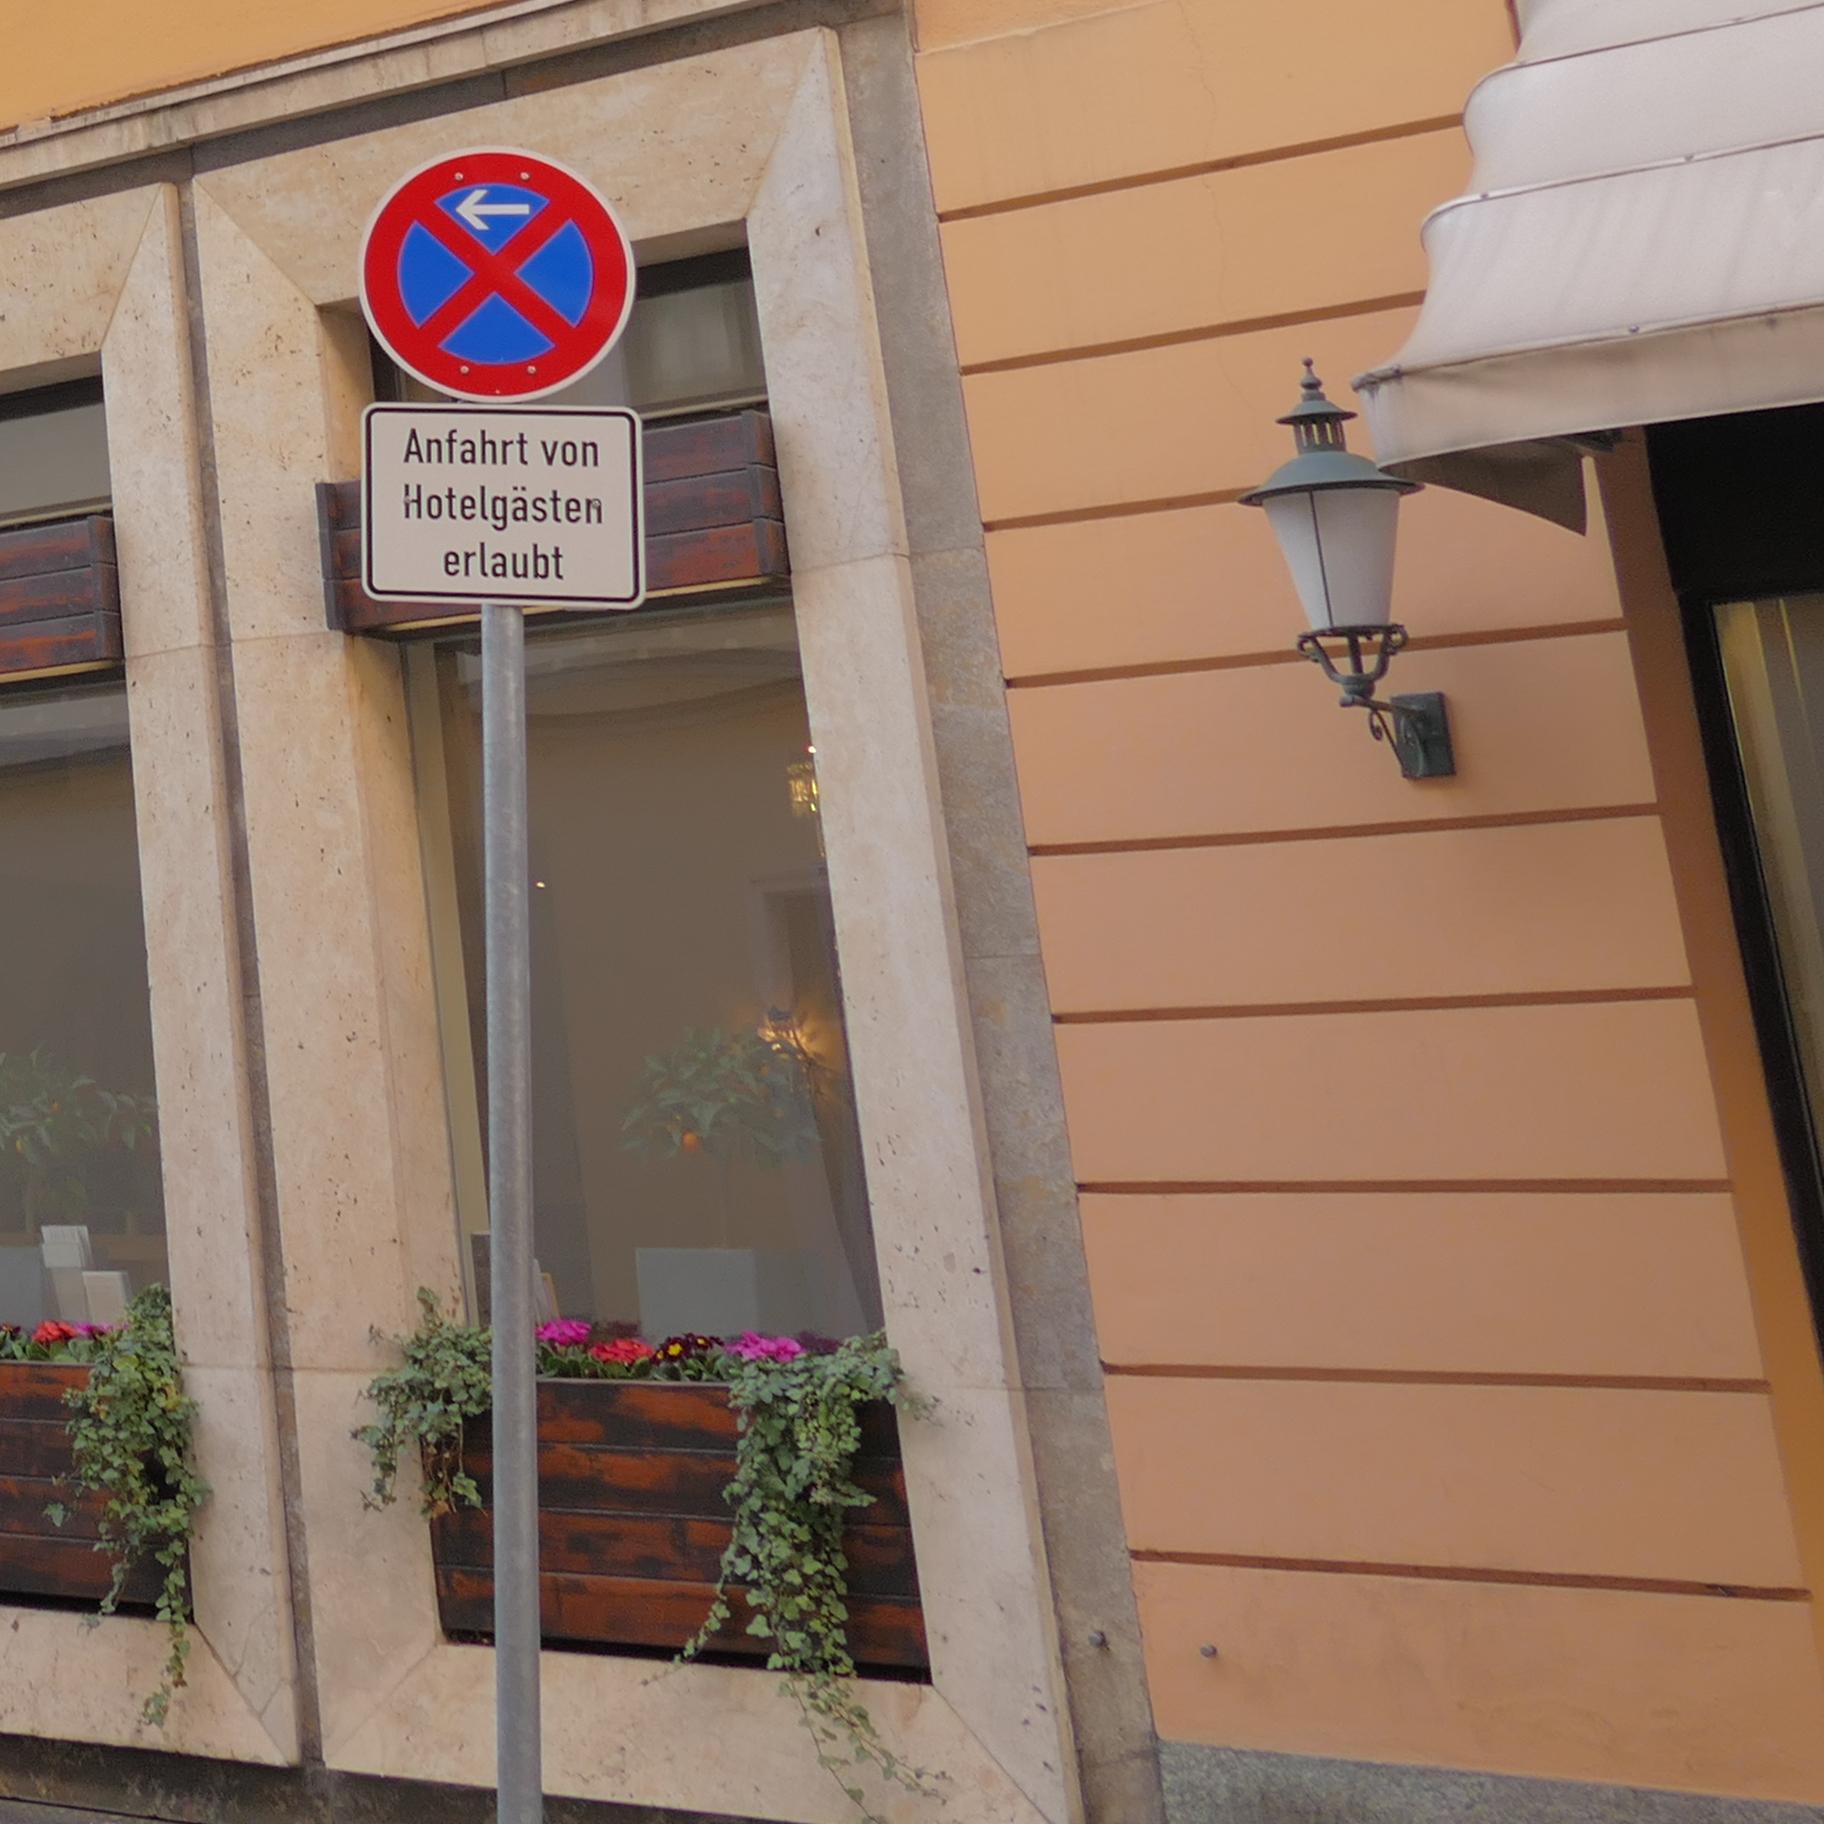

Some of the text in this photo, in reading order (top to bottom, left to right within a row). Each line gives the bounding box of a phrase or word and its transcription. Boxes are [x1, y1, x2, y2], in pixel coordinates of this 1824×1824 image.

[403, 427, 600, 468] Anfahrt von
[403, 483, 603, 532] Hotelgästen
[443, 542, 564, 581] erlaubt
